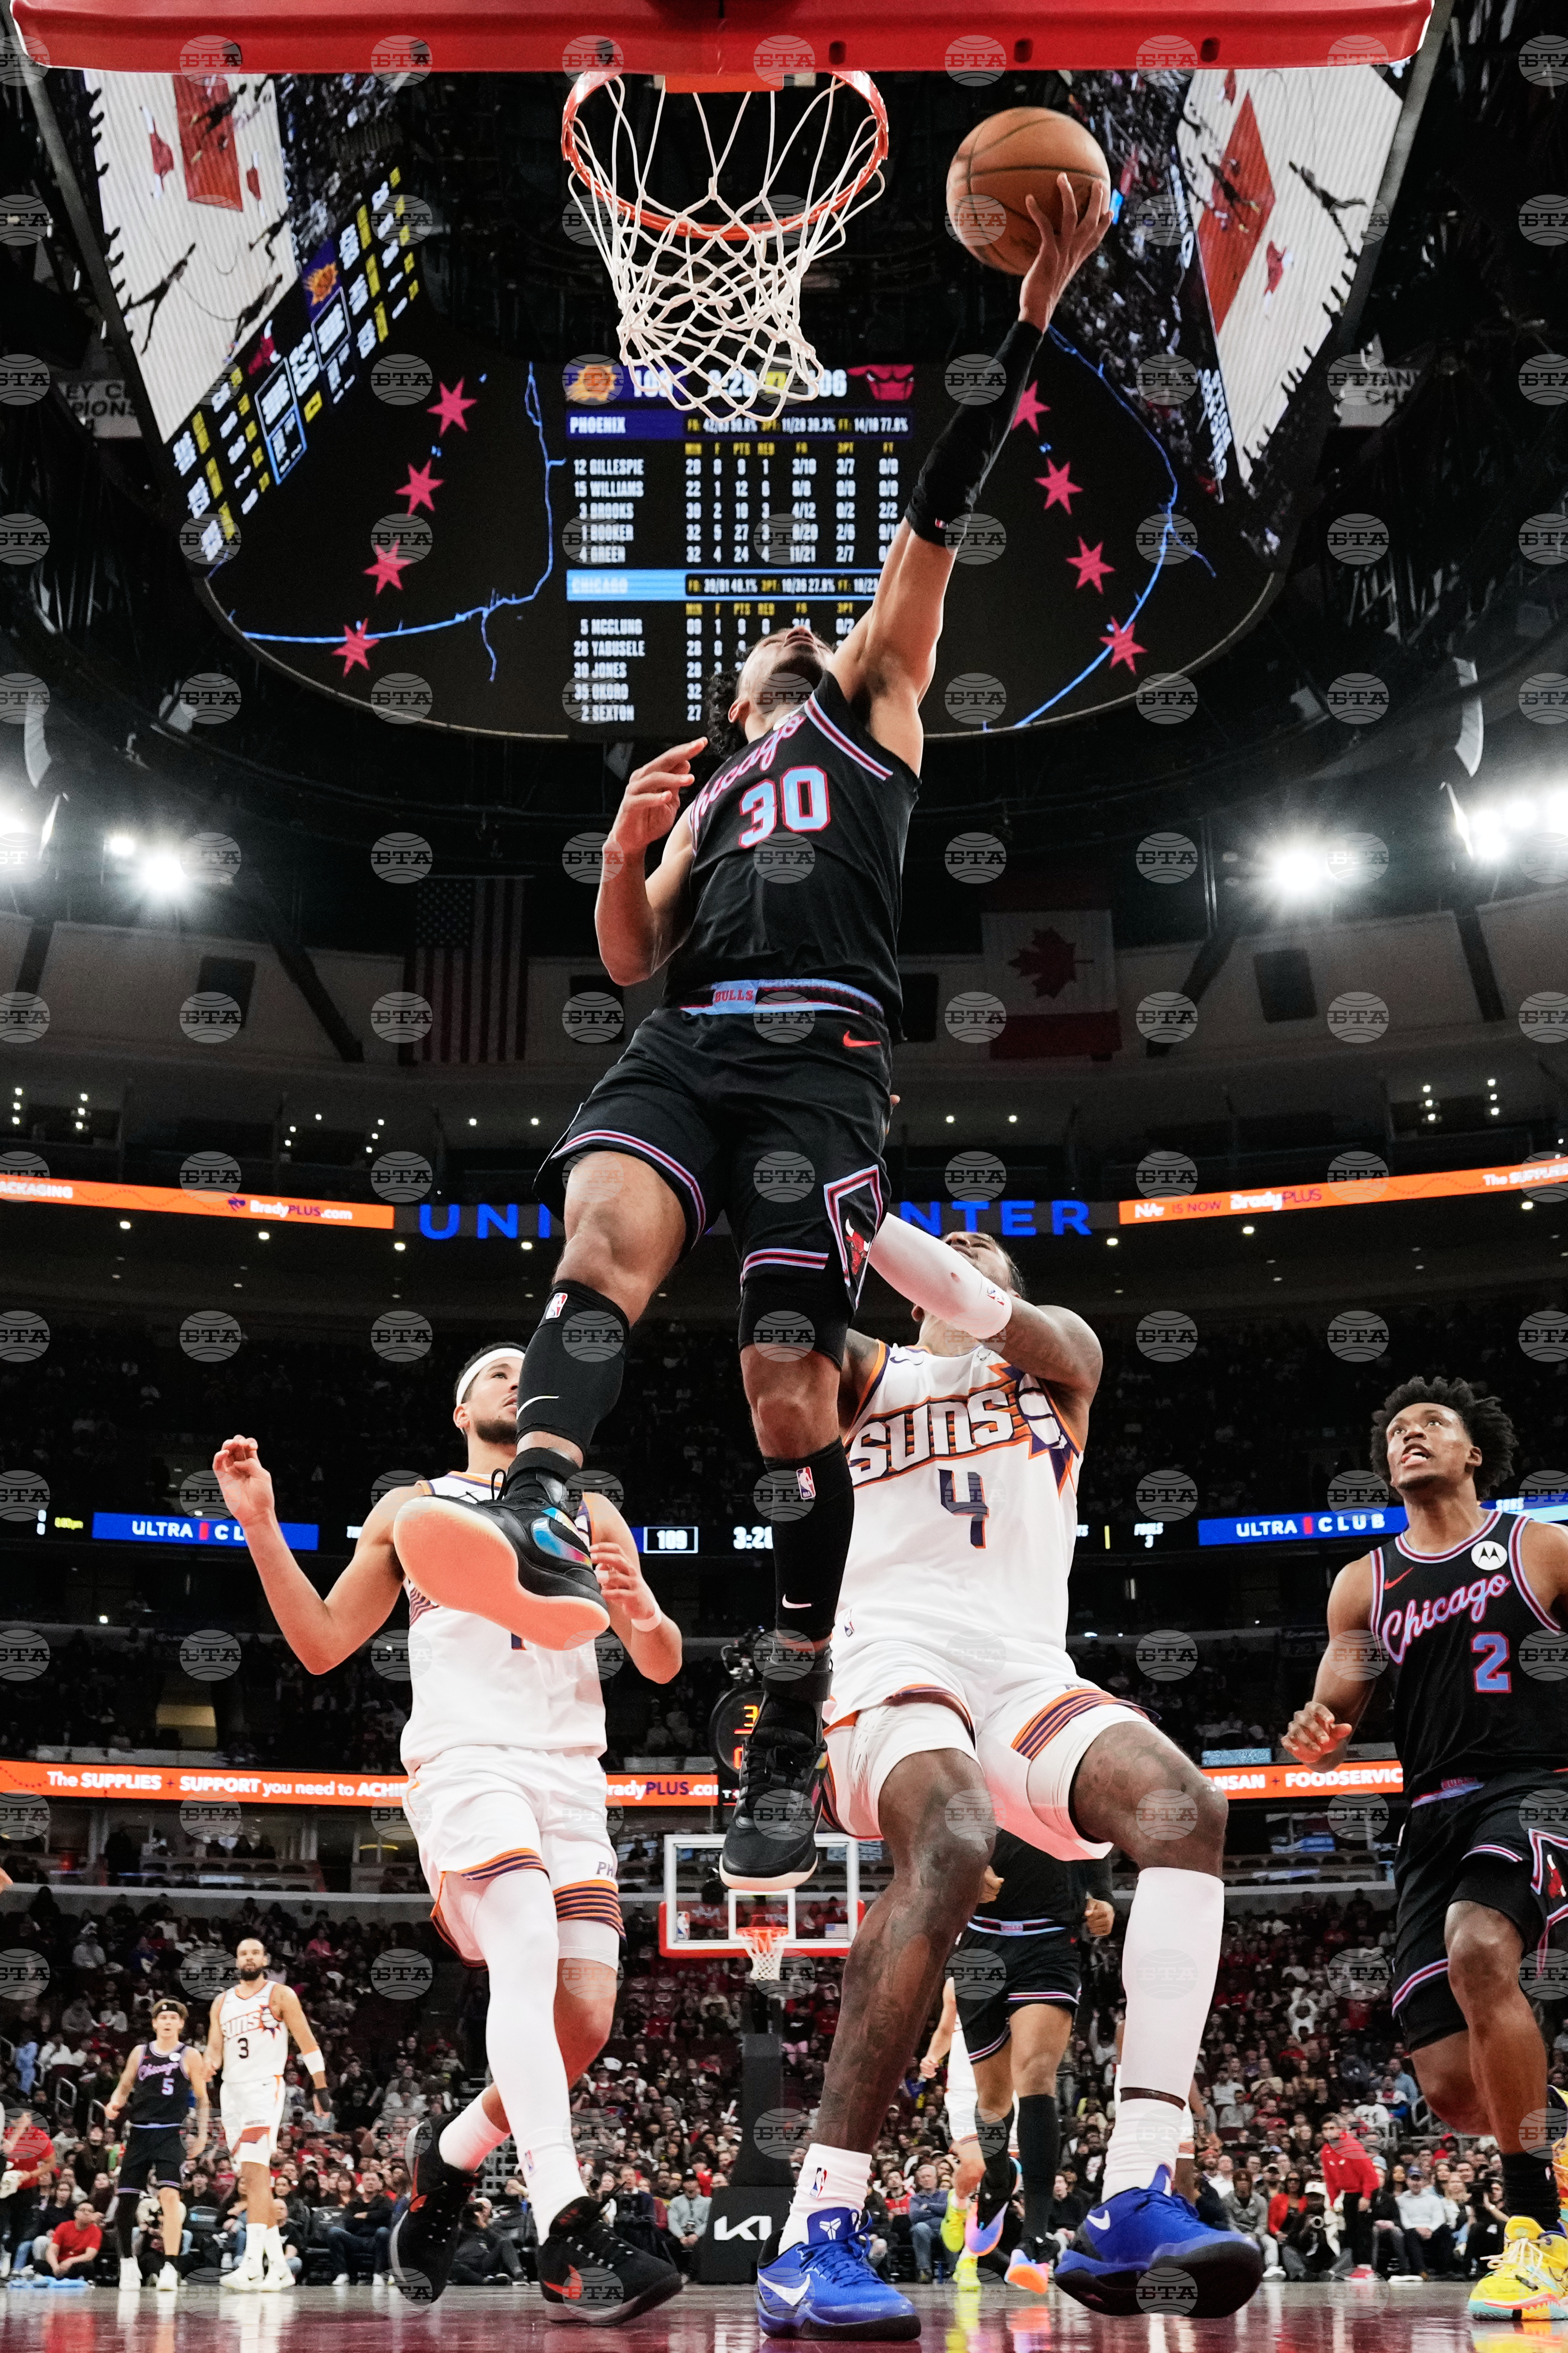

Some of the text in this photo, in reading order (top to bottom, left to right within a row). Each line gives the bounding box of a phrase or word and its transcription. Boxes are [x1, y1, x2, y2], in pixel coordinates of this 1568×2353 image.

[570, 416, 626, 434] PHOENIX
[574, 459, 587, 475] 12
[590, 459, 644, 475] GILLESPIE
[762, 459, 768, 475] 1
[836, 458, 855, 475] 3/7
[590, 480, 644, 497] WILLIAMS
[686, 480, 701, 497] 22
[715, 480, 721, 497] 1
[735, 480, 748, 497] 12
[580, 503, 587, 519] 3
[714, 502, 722, 519] 2
[792, 502, 816, 519] 4/12
[879, 502, 897, 519] 2/2
[581, 525, 587, 541] 1
[686, 524, 701, 541] 32
[734, 524, 749, 541] 27
[579, 546, 587, 562] 4
[591, 546, 625, 562] GREEN
[686, 546, 701, 562] 32
[714, 546, 721, 562] 4
[734, 546, 749, 562] 24
[761, 546, 769, 562] 4
[836, 545, 854, 562] 2/7
[572, 577, 628, 594] CHICAGO
[580, 619, 589, 635] 5
[715, 619, 721, 635] 1
[591, 640, 646, 657] YABUSELE
[574, 662, 589, 678] 30
[592, 662, 627, 678] JONES
[575, 684, 589, 700] 35
[687, 683, 702, 699] 32
[581, 705, 701, 721] 2 SEXTON 27
[690, 715, 807, 832] hicago
[738, 764, 831, 849] 30
[713, 989, 753, 1003] BULLS
[1482, 1174, 1507, 1186] The
[1173, 1204, 1183, 1214] IS
[1186, 1200, 1222, 1212] NOW
[1230, 1187, 1323, 1211] BradyPLUS
[250, 1201, 353, 1220] BradyPLUS.com
[418, 1201, 1092, 1239] UNI NTER
[937, 1469, 990, 1549] 4
[1495, 1497, 1524, 1512] SUNS
[131, 1521, 246, 1541] ULTRA CL
[1235, 1514, 1385, 1537] ULTRA CLUB
[656, 1529, 688, 1550] 109
[1145, 1536, 1154, 1548] 3
[1381, 1574, 1512, 1664] Chicago
[1470, 1631, 1512, 1693] 2
[47, 1770, 79, 1789] The
[80, 1772, 162, 1791] SUPPLIES
[179, 1775, 261, 1794] SUPPORT
[262, 1781, 293, 1798] you
[294, 1780, 335, 1796] need
[337, 1782, 355, 1797] to
[606, 1780, 718, 1800] radyPLUS.co
[596, 1861, 614, 1877] PH
[237, 2037, 249, 2059] 3
[161, 2078, 175, 2095] 5
